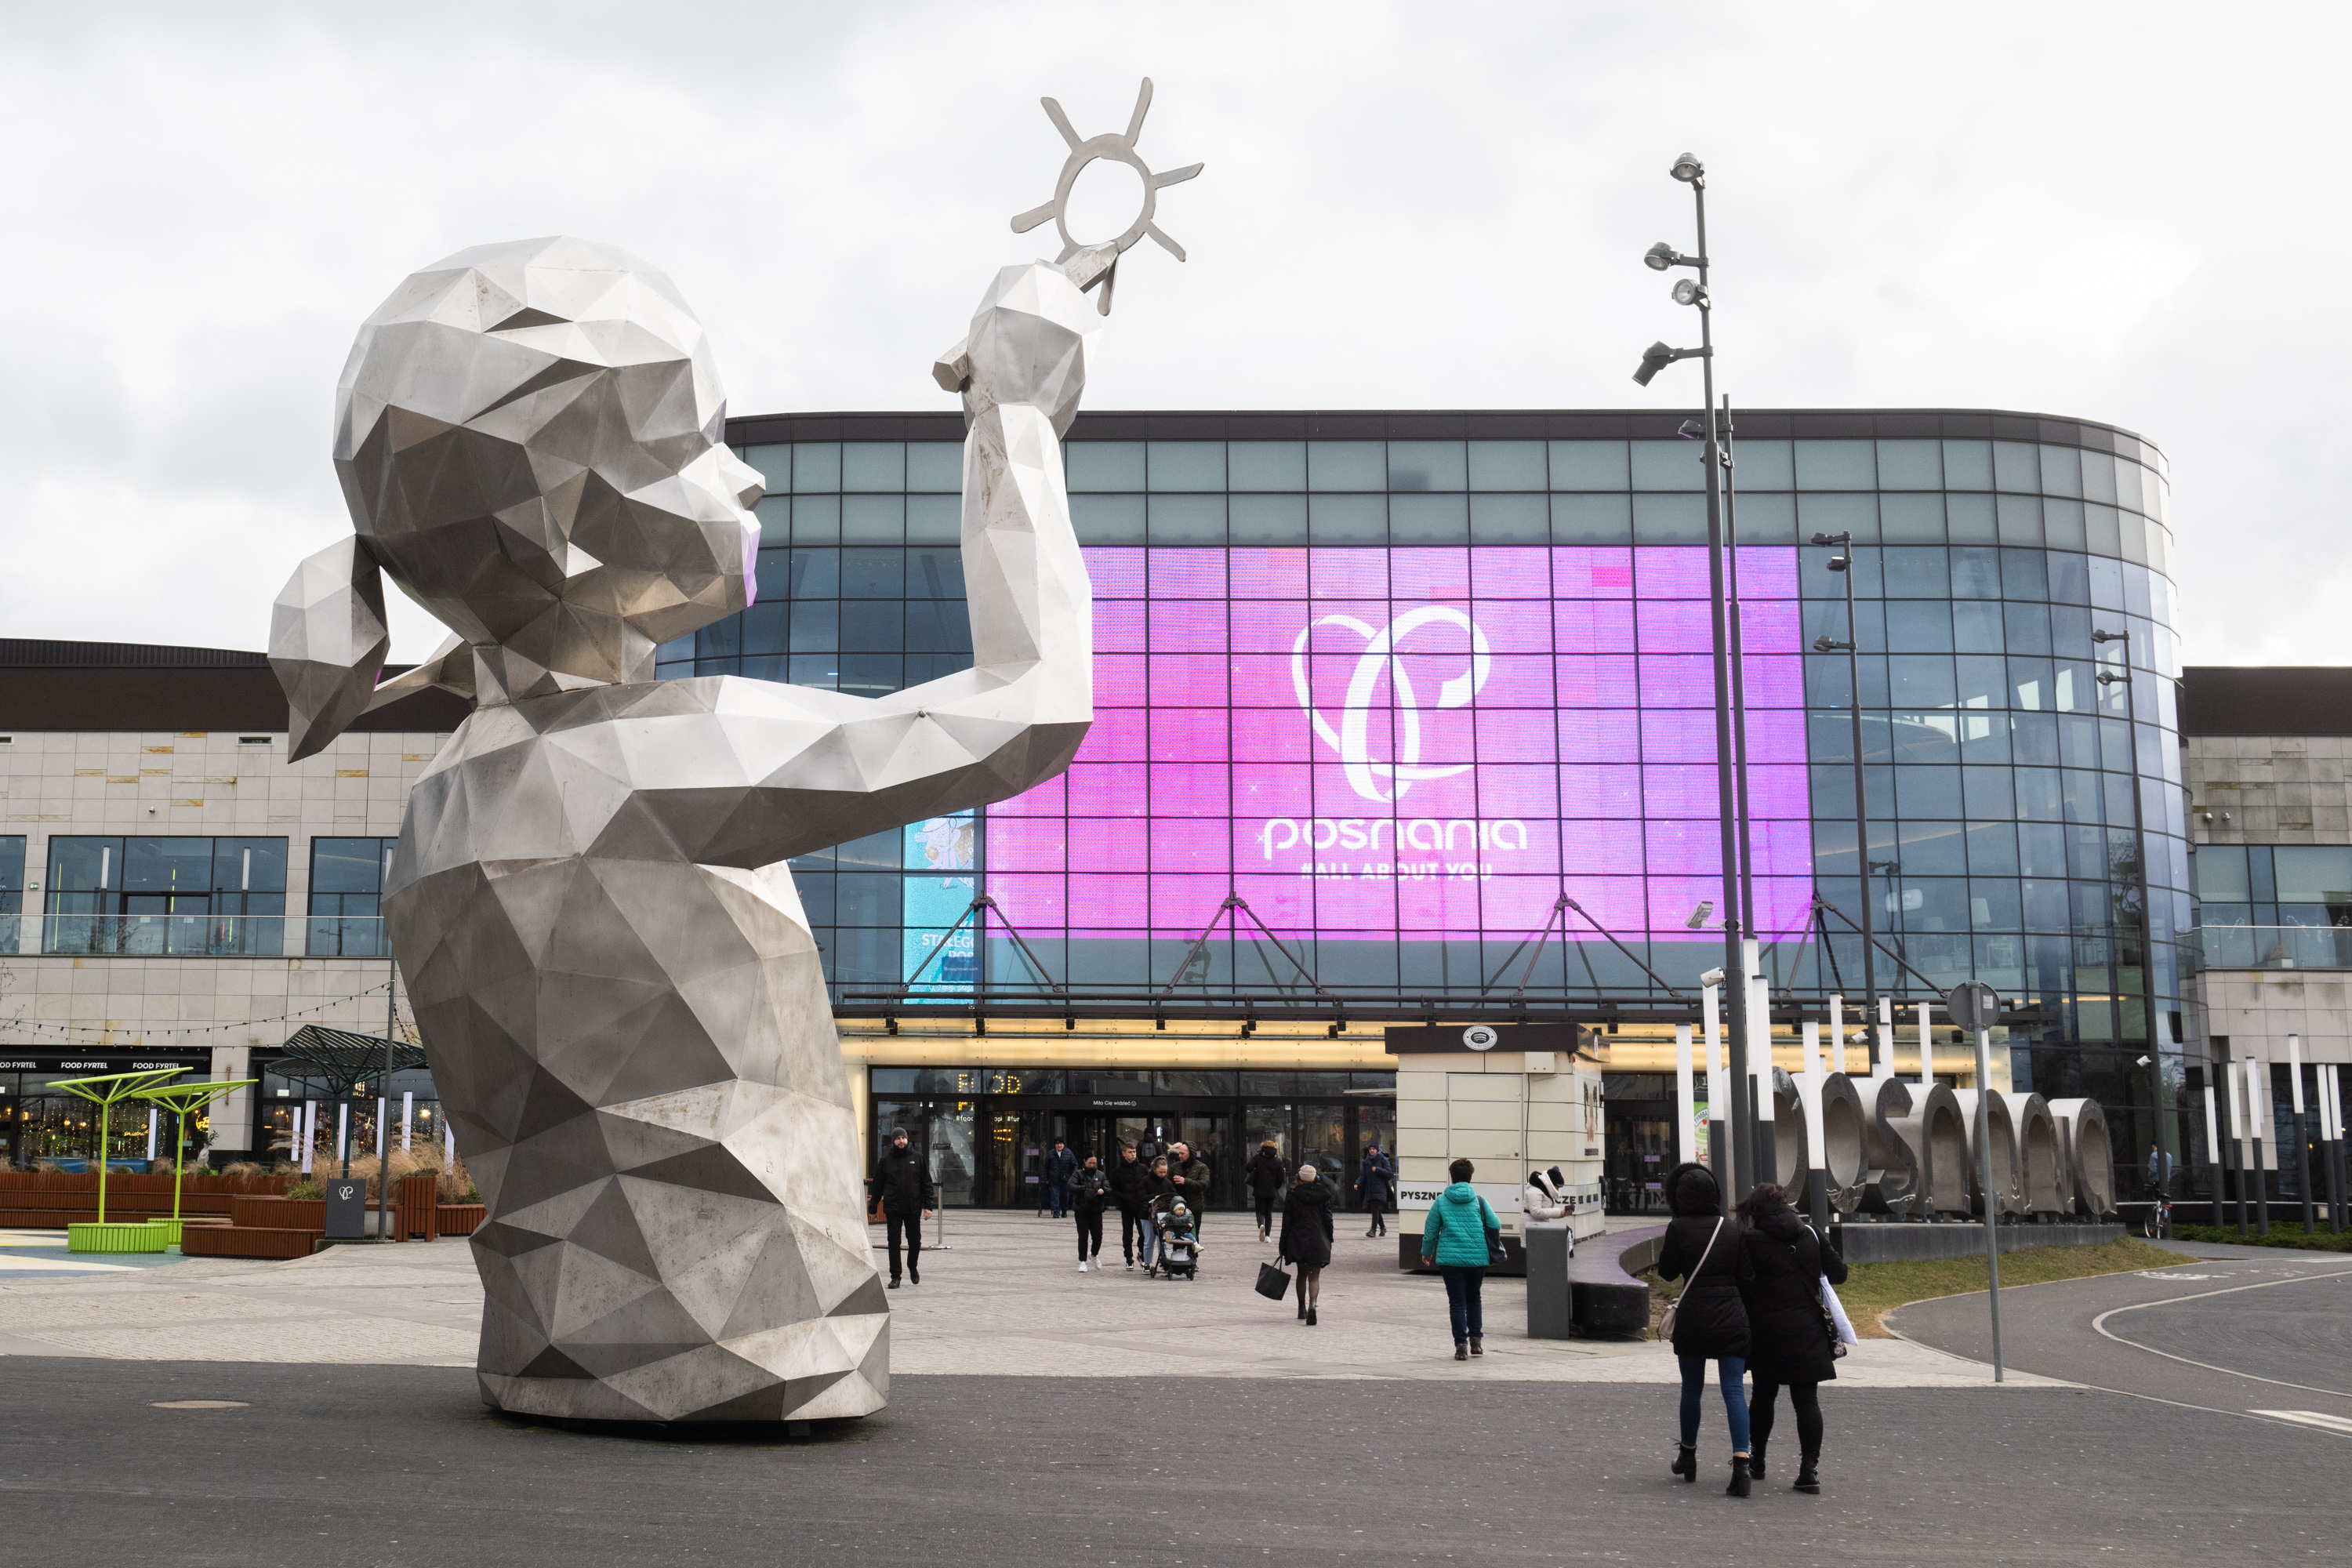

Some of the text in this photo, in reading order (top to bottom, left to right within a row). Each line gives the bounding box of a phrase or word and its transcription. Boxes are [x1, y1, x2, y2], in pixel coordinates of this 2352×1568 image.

[1264, 817, 1527, 860] posnania
[1300, 862, 1493, 880] #ALL ABOUT YOU
[958, 1073, 1021, 1094] FOD
